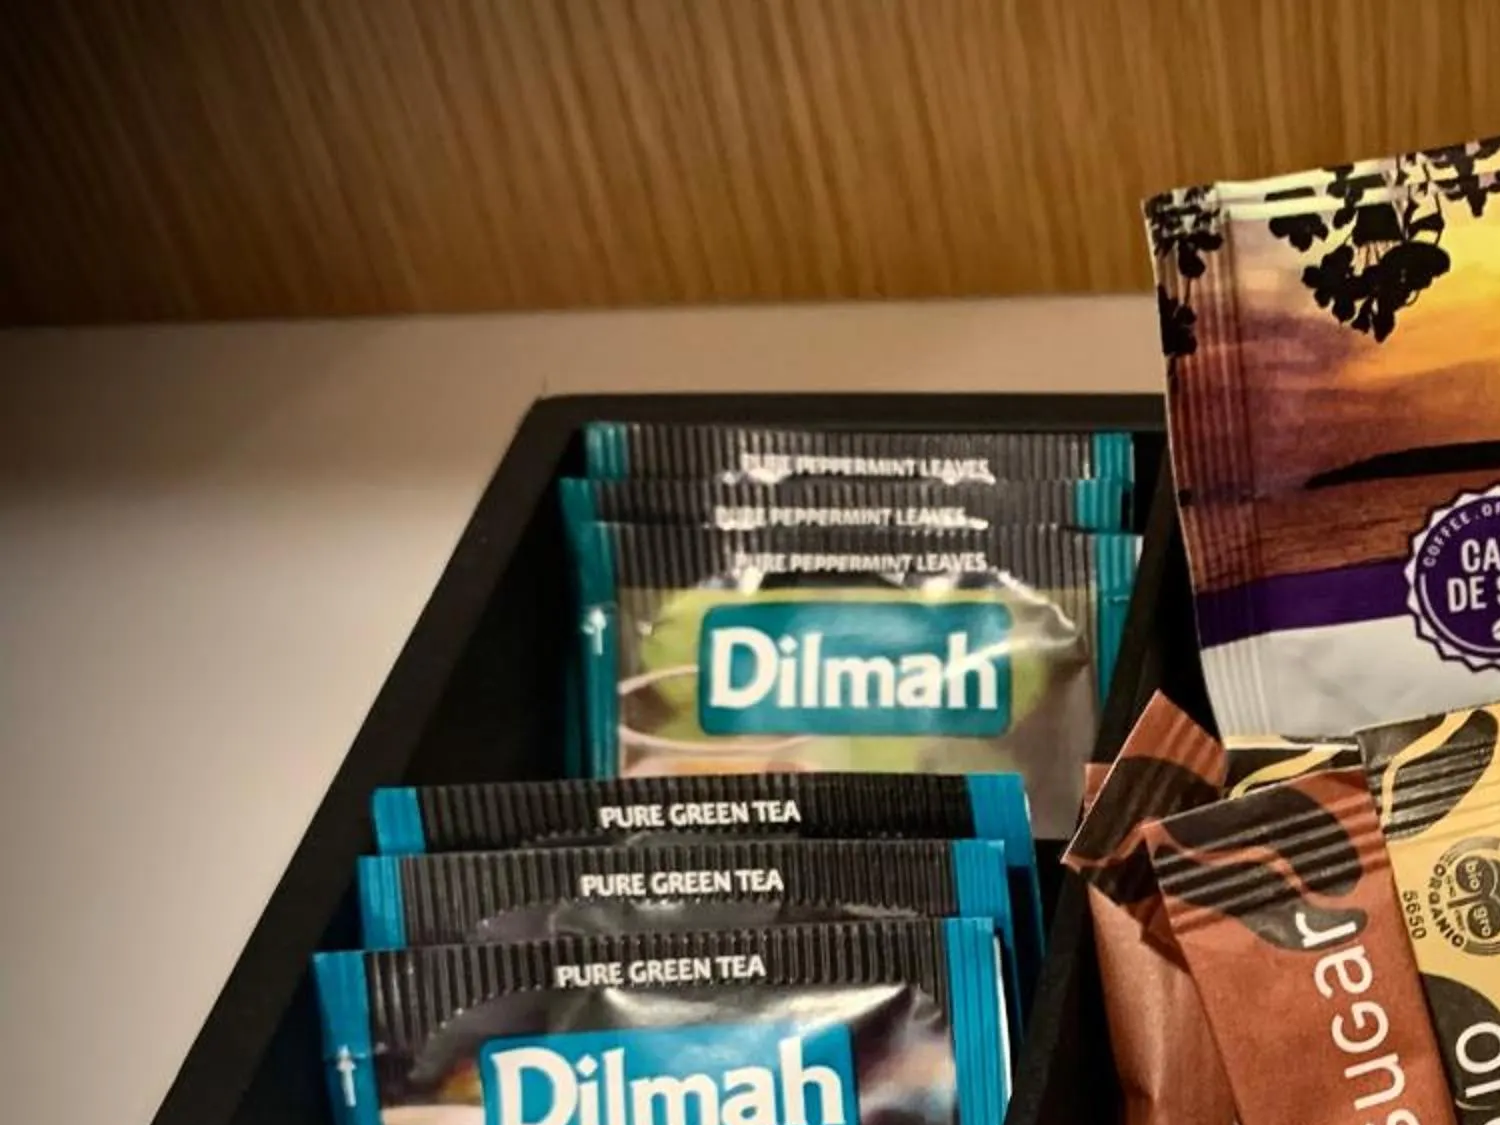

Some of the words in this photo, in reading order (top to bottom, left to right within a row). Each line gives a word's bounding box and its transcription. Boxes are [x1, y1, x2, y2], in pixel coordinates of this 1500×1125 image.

[795, 455, 915, 477] PEPPERMINT
[769, 507, 892, 527] PEPPERMINT
[1423, 511, 1471, 567] COFFEE
[735, 552, 786, 572] PURE
[789, 552, 911, 572] PEPPERMINT
[916, 553, 987, 572] LEAVES
[1446, 576, 1487, 613] DE
[710, 626, 998, 709] Dilmah
[599, 804, 664, 828] PURE
[668, 801, 749, 825] GREEN
[752, 799, 801, 823] TEA
[580, 872, 646, 897] PURE
[651, 870, 731, 895] GREEN
[735, 867, 784, 892] TEA
[1402, 889, 1427, 940] 5650
[556, 962, 624, 988] PURE
[628, 956, 712, 984] GREEN
[715, 953, 766, 979] TEA
